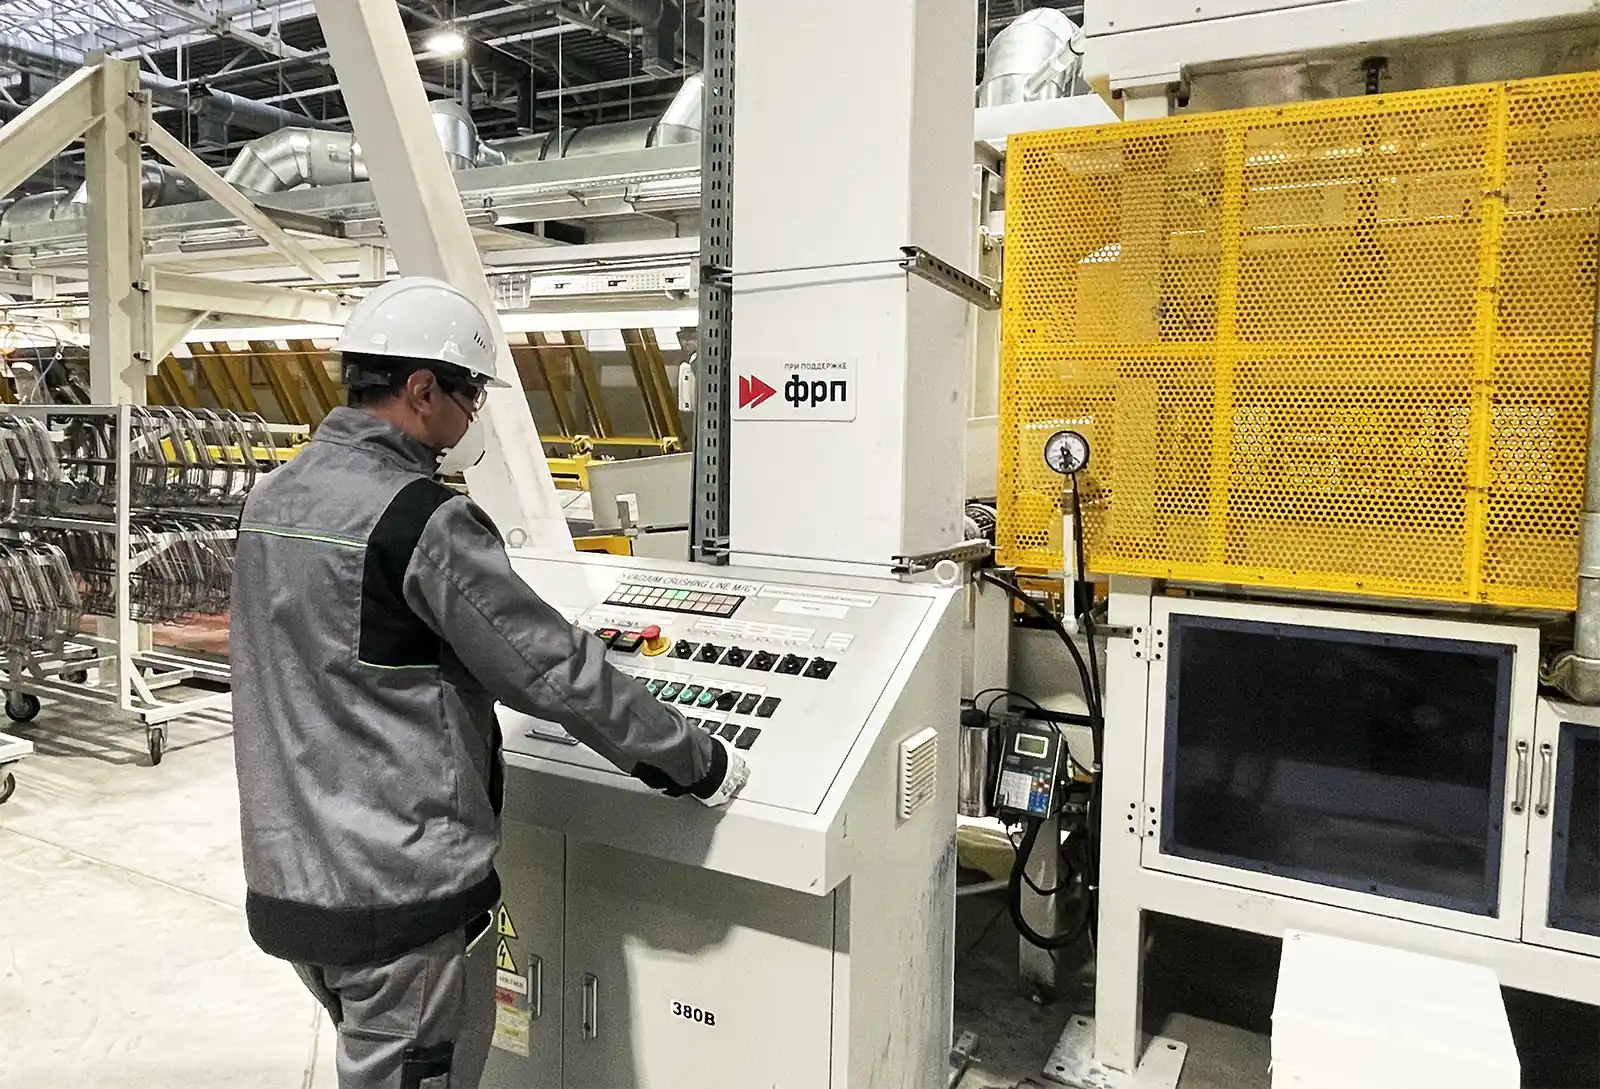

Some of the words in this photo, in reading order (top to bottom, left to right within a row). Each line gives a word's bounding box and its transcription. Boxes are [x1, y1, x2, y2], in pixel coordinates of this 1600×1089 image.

[800, 362, 847, 370] ПОДДЕРЖКЕ
[626, 573, 663, 583] VACUUM
[662, 577, 709, 588] CRUSHING
[709, 580, 731, 590] LINE
